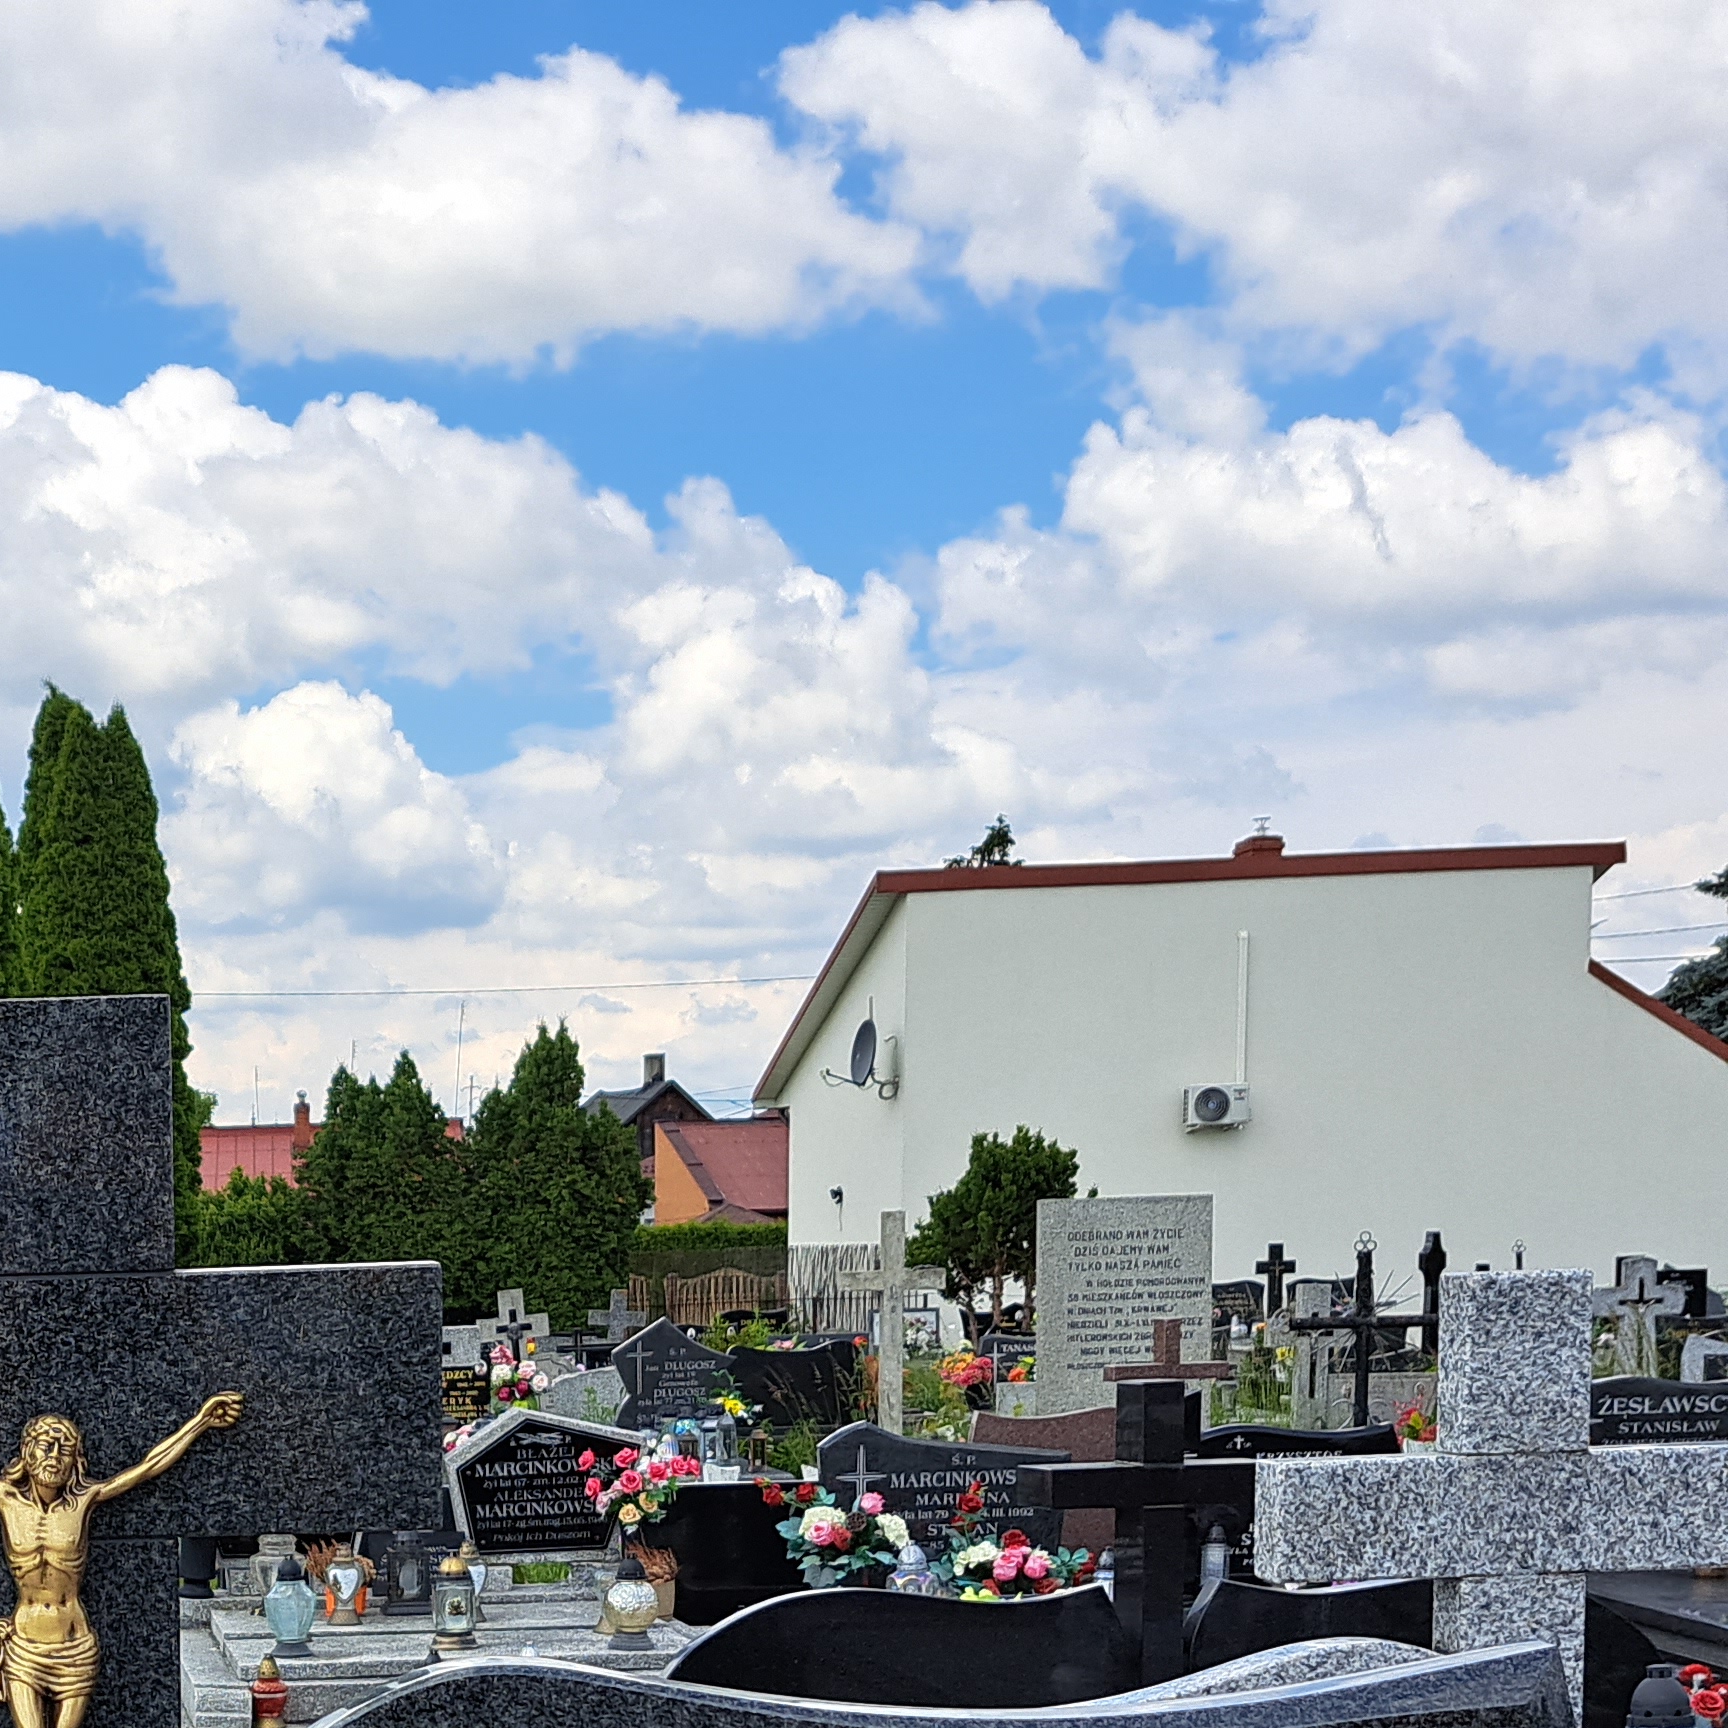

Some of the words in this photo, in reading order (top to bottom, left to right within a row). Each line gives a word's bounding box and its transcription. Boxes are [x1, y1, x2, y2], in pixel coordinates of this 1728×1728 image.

[1597, 1394, 1728, 1420] ŻĘSŁAWSC
[890, 1469, 1017, 1488] MARCINKOWS
[475, 1499, 594, 1519] MARCINKOWS
